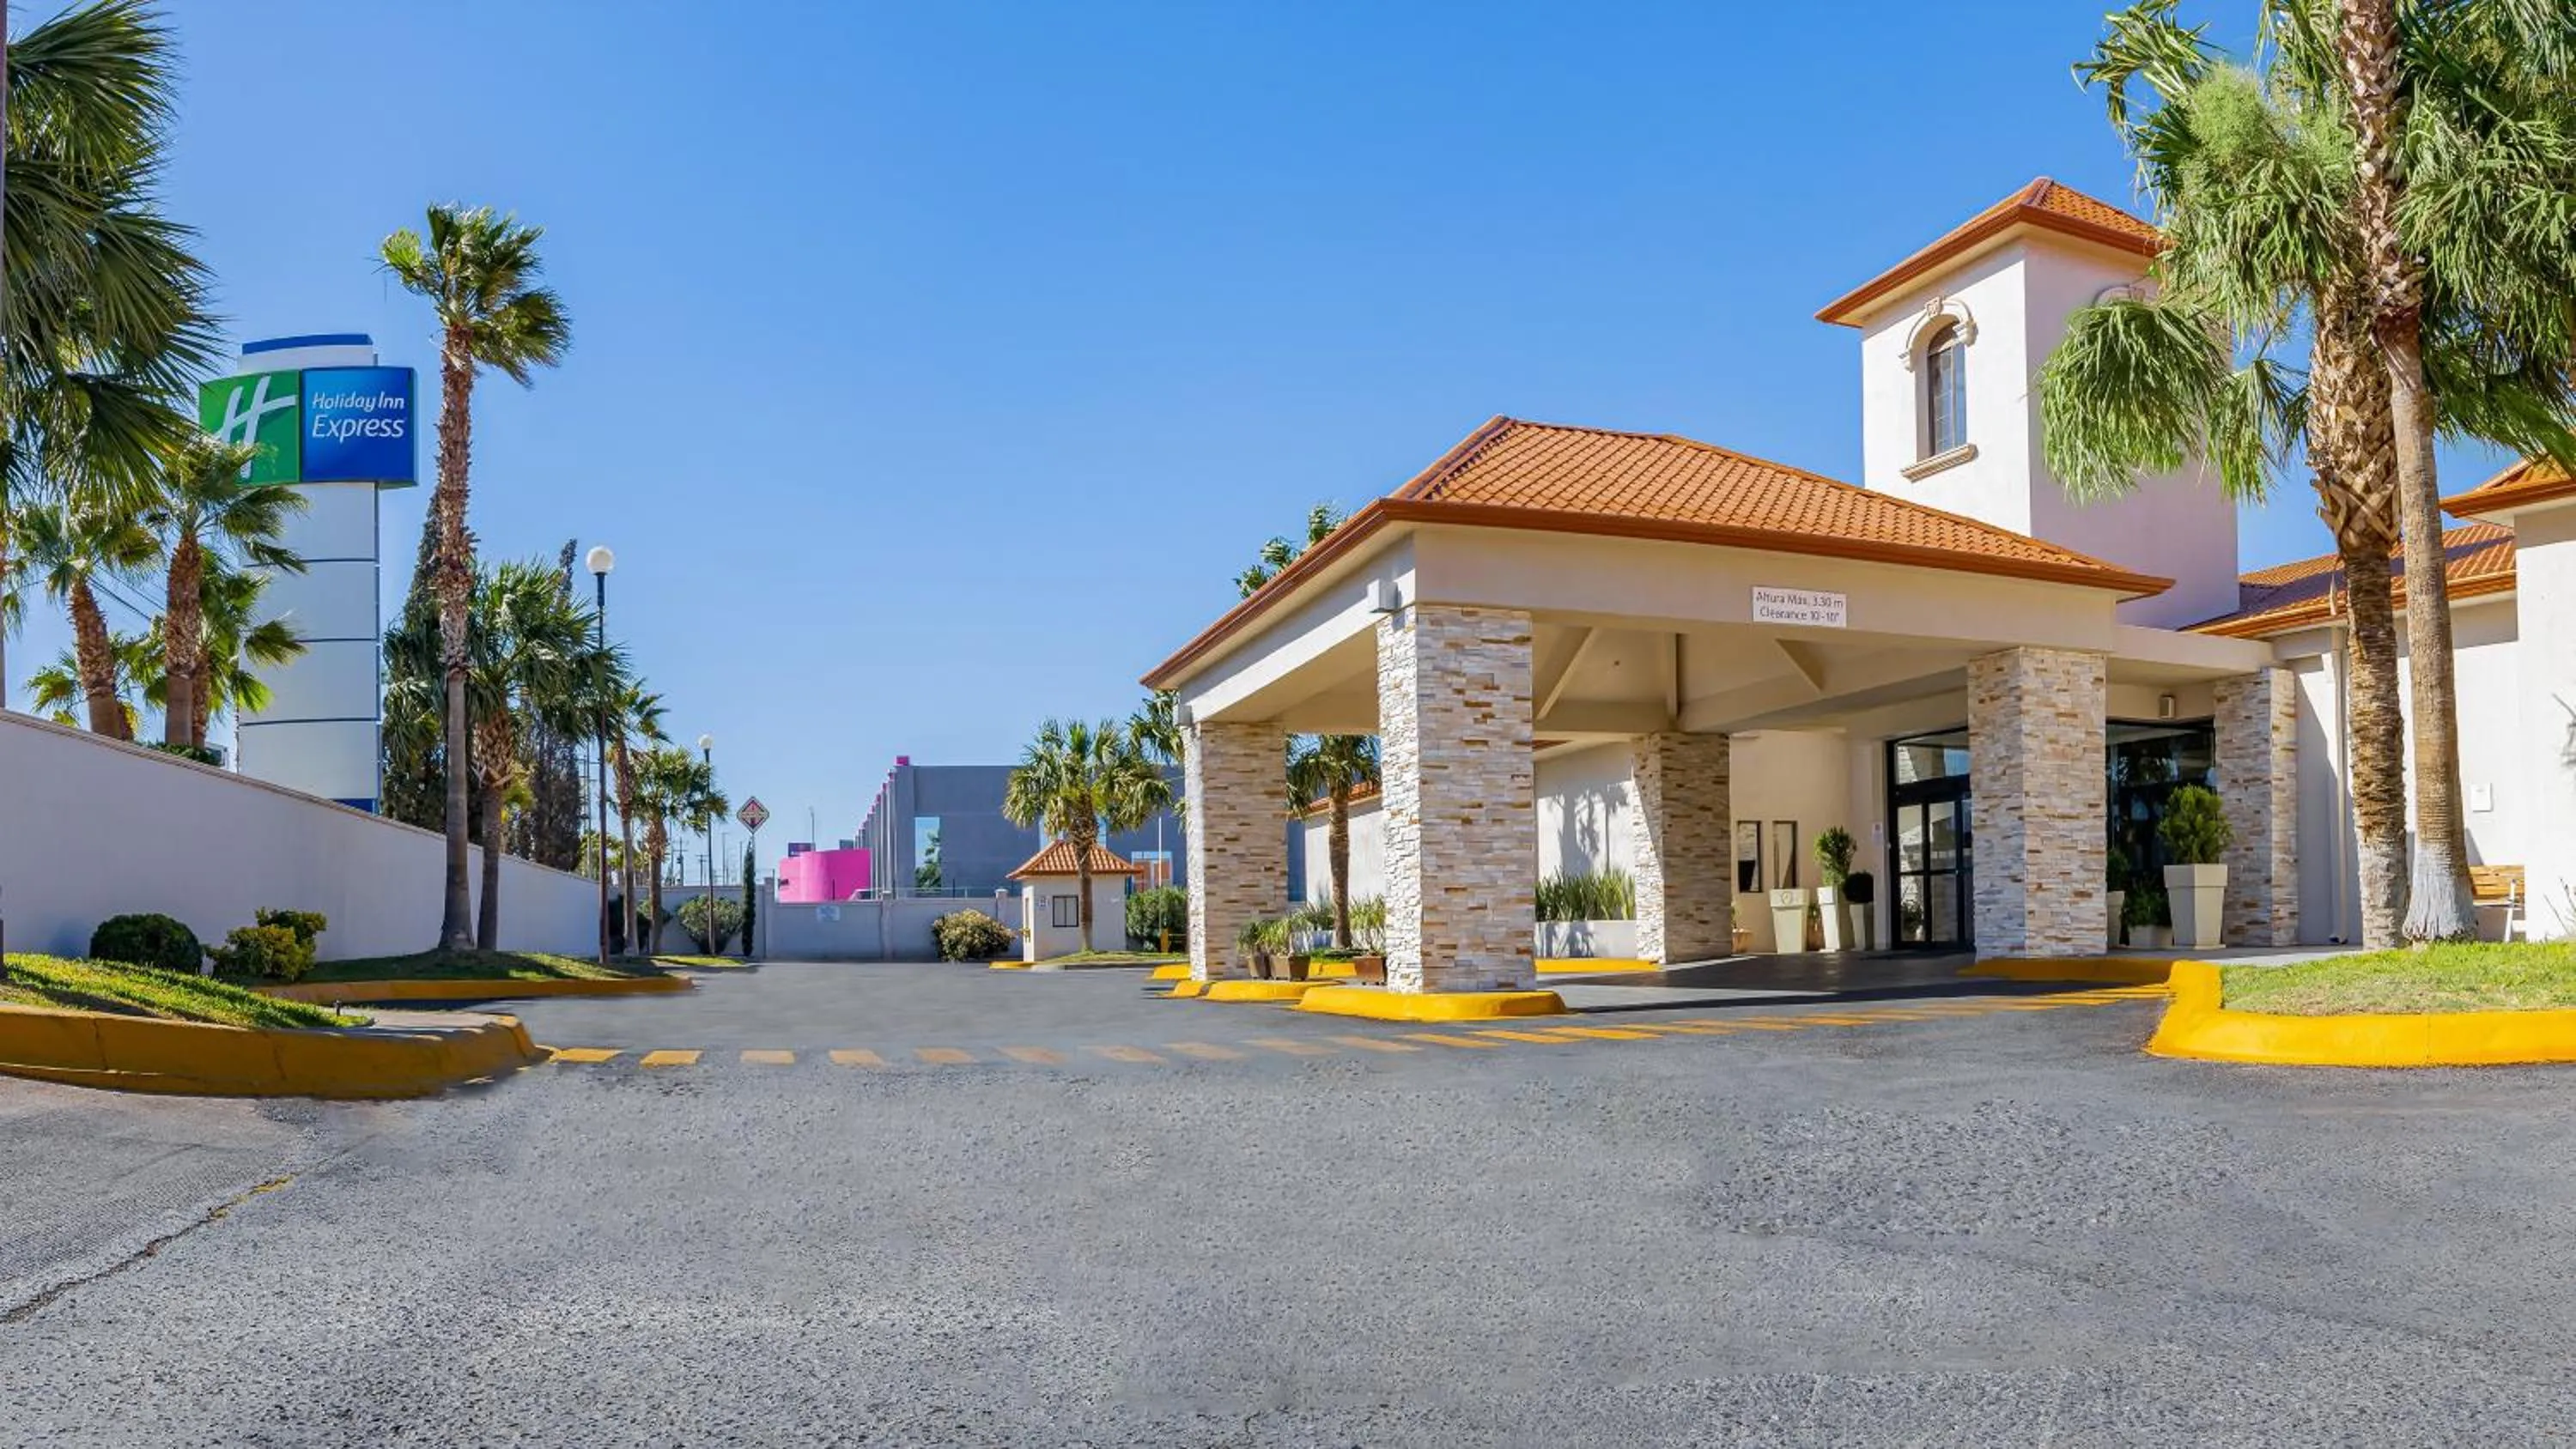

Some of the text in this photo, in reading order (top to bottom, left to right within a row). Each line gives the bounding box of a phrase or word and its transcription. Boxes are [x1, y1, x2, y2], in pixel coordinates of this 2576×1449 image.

[312, 391, 404, 412] Holiday Inn
[312, 413, 404, 444] Express
[1759, 605, 1807, 620] Clearance
